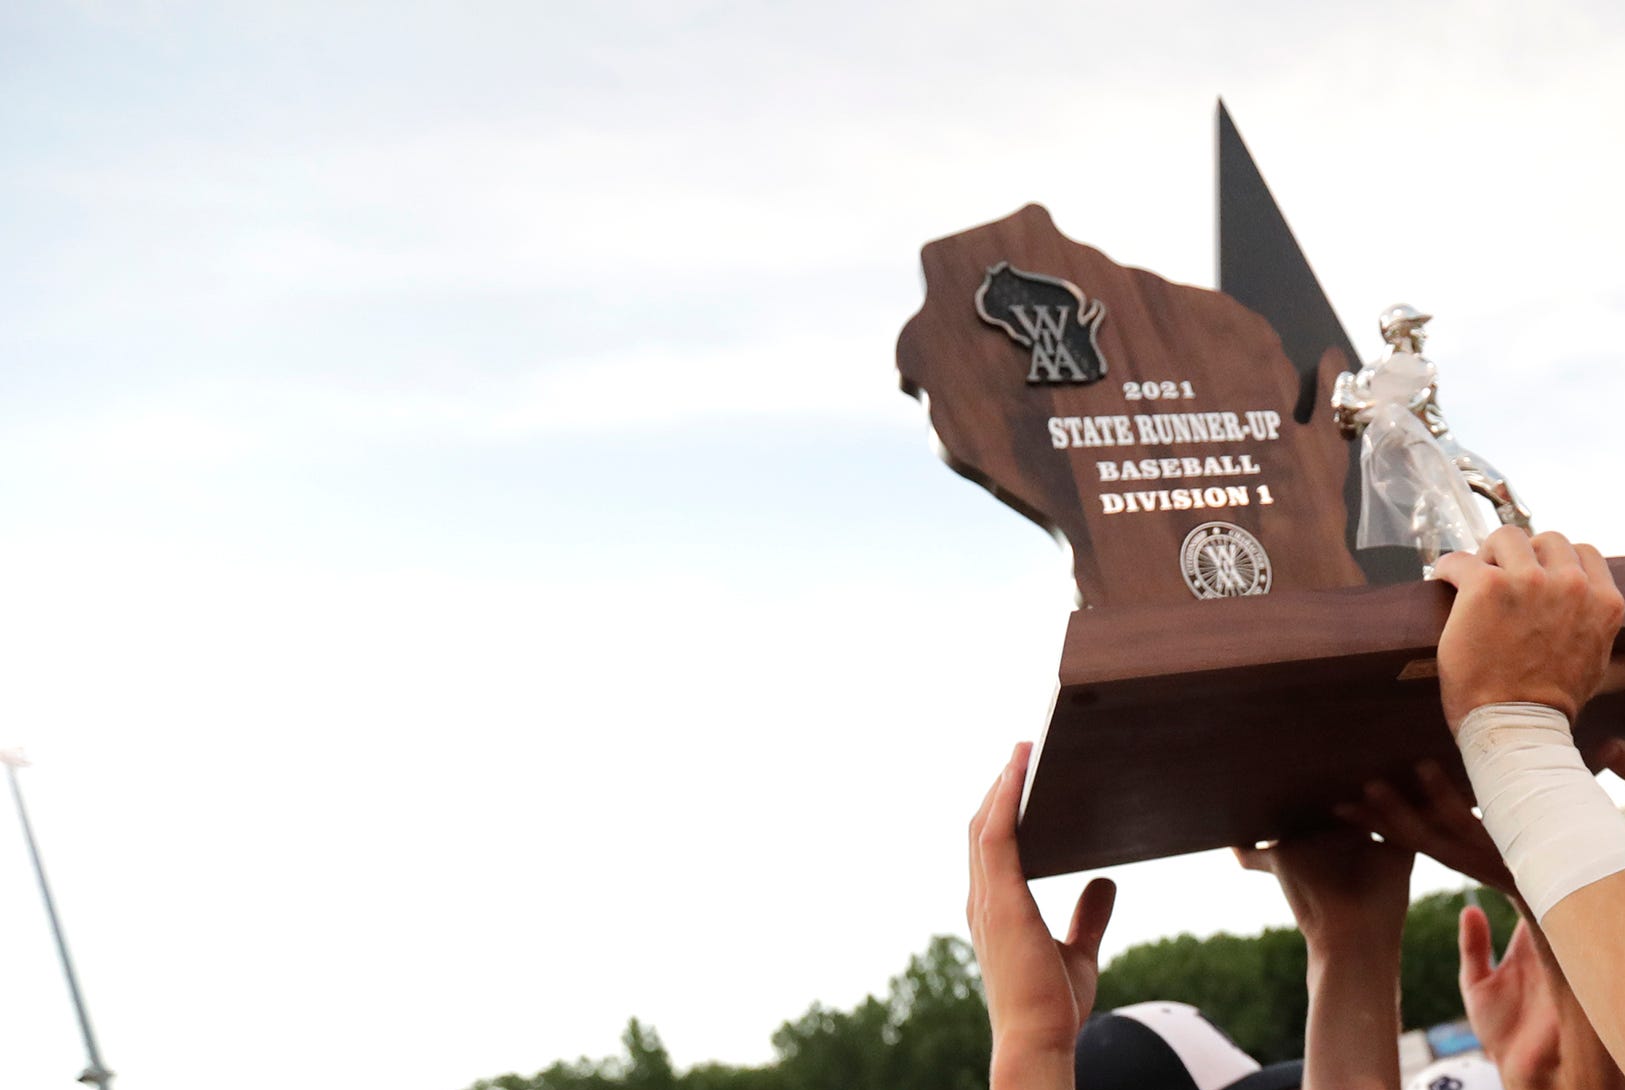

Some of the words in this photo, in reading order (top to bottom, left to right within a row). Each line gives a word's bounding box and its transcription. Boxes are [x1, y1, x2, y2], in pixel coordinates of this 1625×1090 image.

[1122, 380, 1196, 400] 2021
[1048, 415, 1135, 449] STATE
[1134, 410, 1281, 445] RUNNER-UP
[1096, 455, 1261, 482] BASEBALL
[1099, 486, 1249, 514] DIVISION
[1256, 485, 1274, 504] 1
